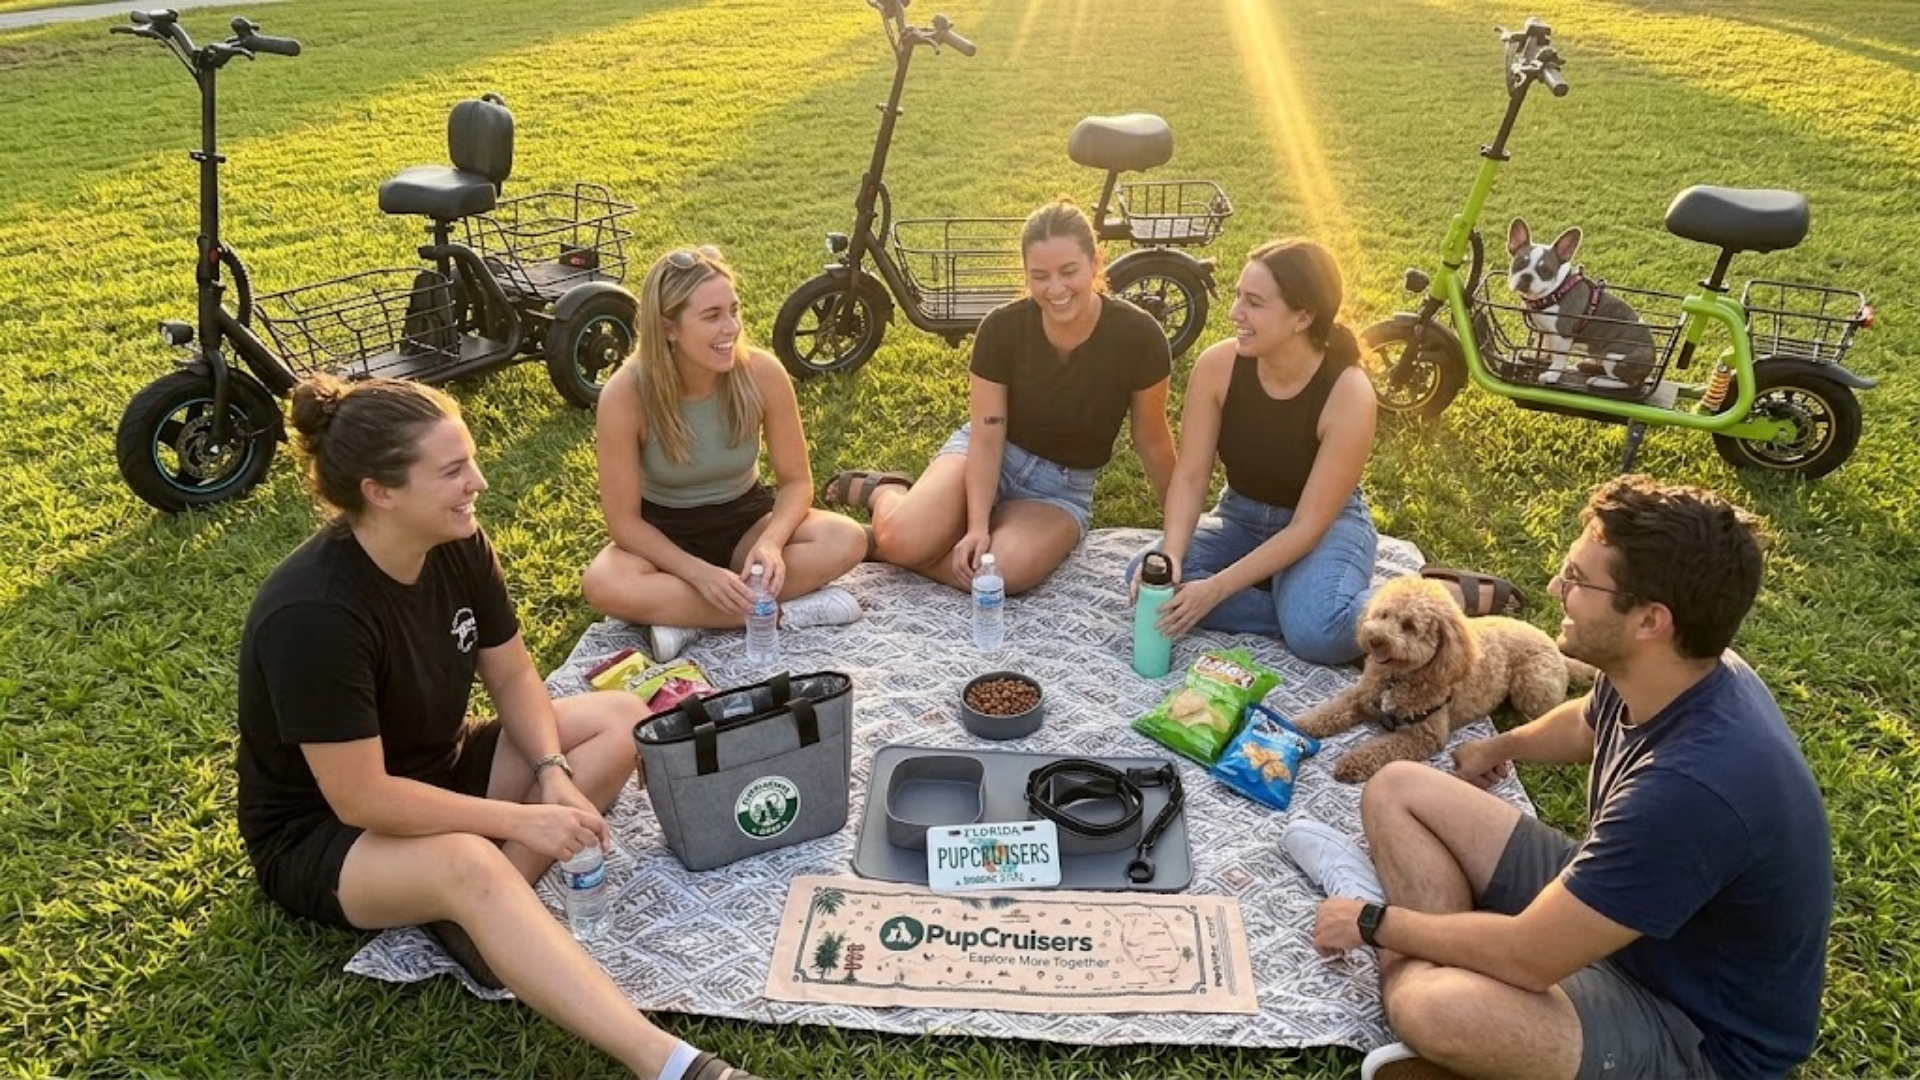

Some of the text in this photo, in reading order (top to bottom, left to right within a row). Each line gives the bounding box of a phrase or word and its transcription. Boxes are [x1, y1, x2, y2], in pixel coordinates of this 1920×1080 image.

[937, 843, 1051, 869] PUPCRUISERS
[925, 924, 1093, 952] PupCruisers
[1020, 955, 1050, 967] More
[1053, 956, 1111, 970] Together
